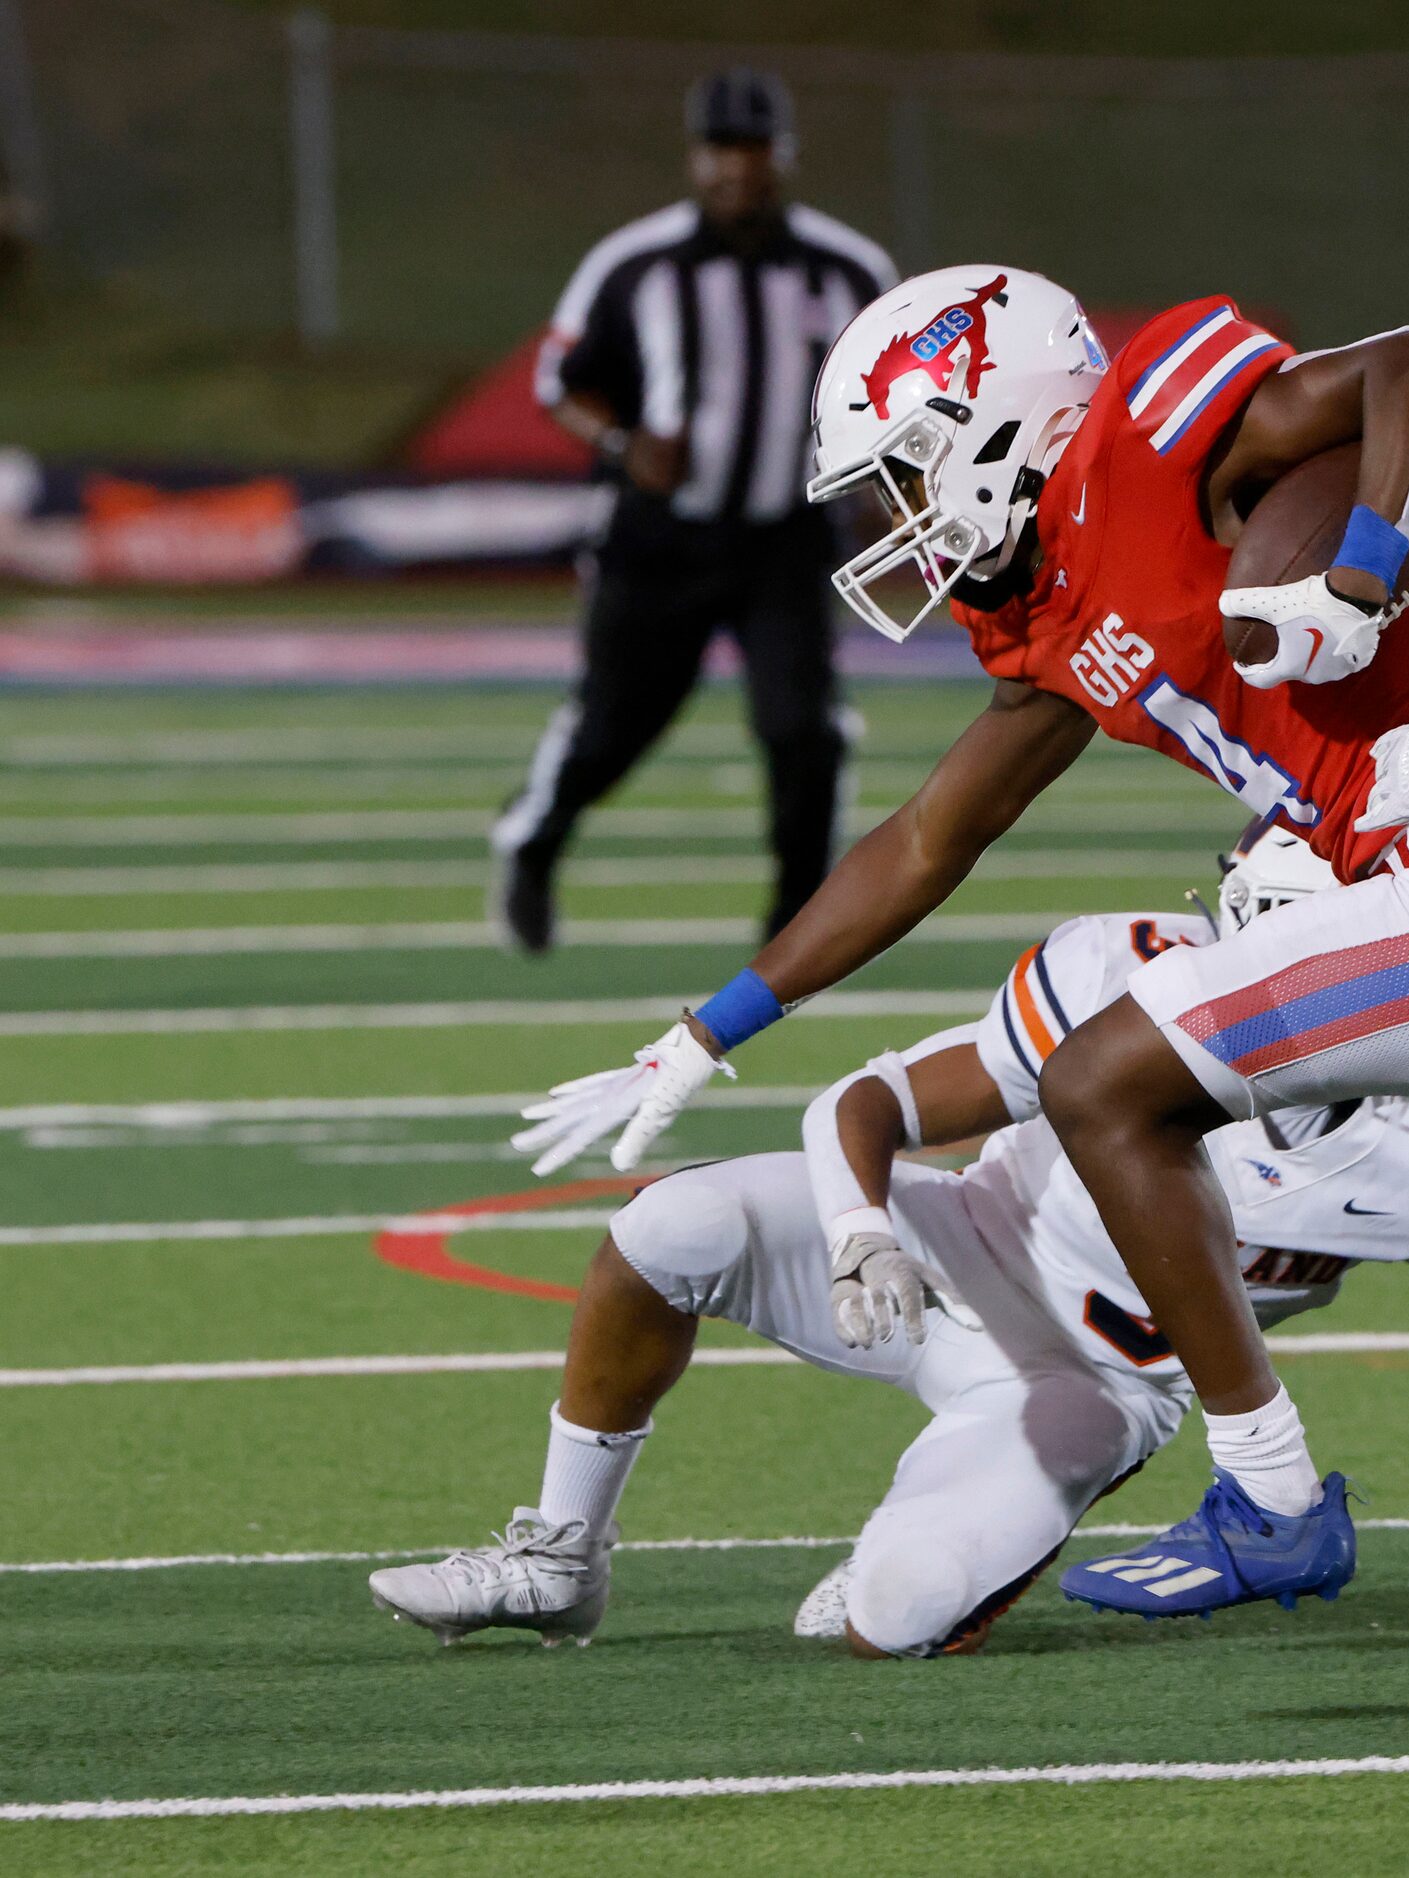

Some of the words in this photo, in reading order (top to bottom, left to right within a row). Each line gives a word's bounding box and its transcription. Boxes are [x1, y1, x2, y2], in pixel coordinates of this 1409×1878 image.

[910, 307, 974, 362] GHS
[1069, 612, 1155, 708] GHS
[1136, 671, 1323, 829] 4
